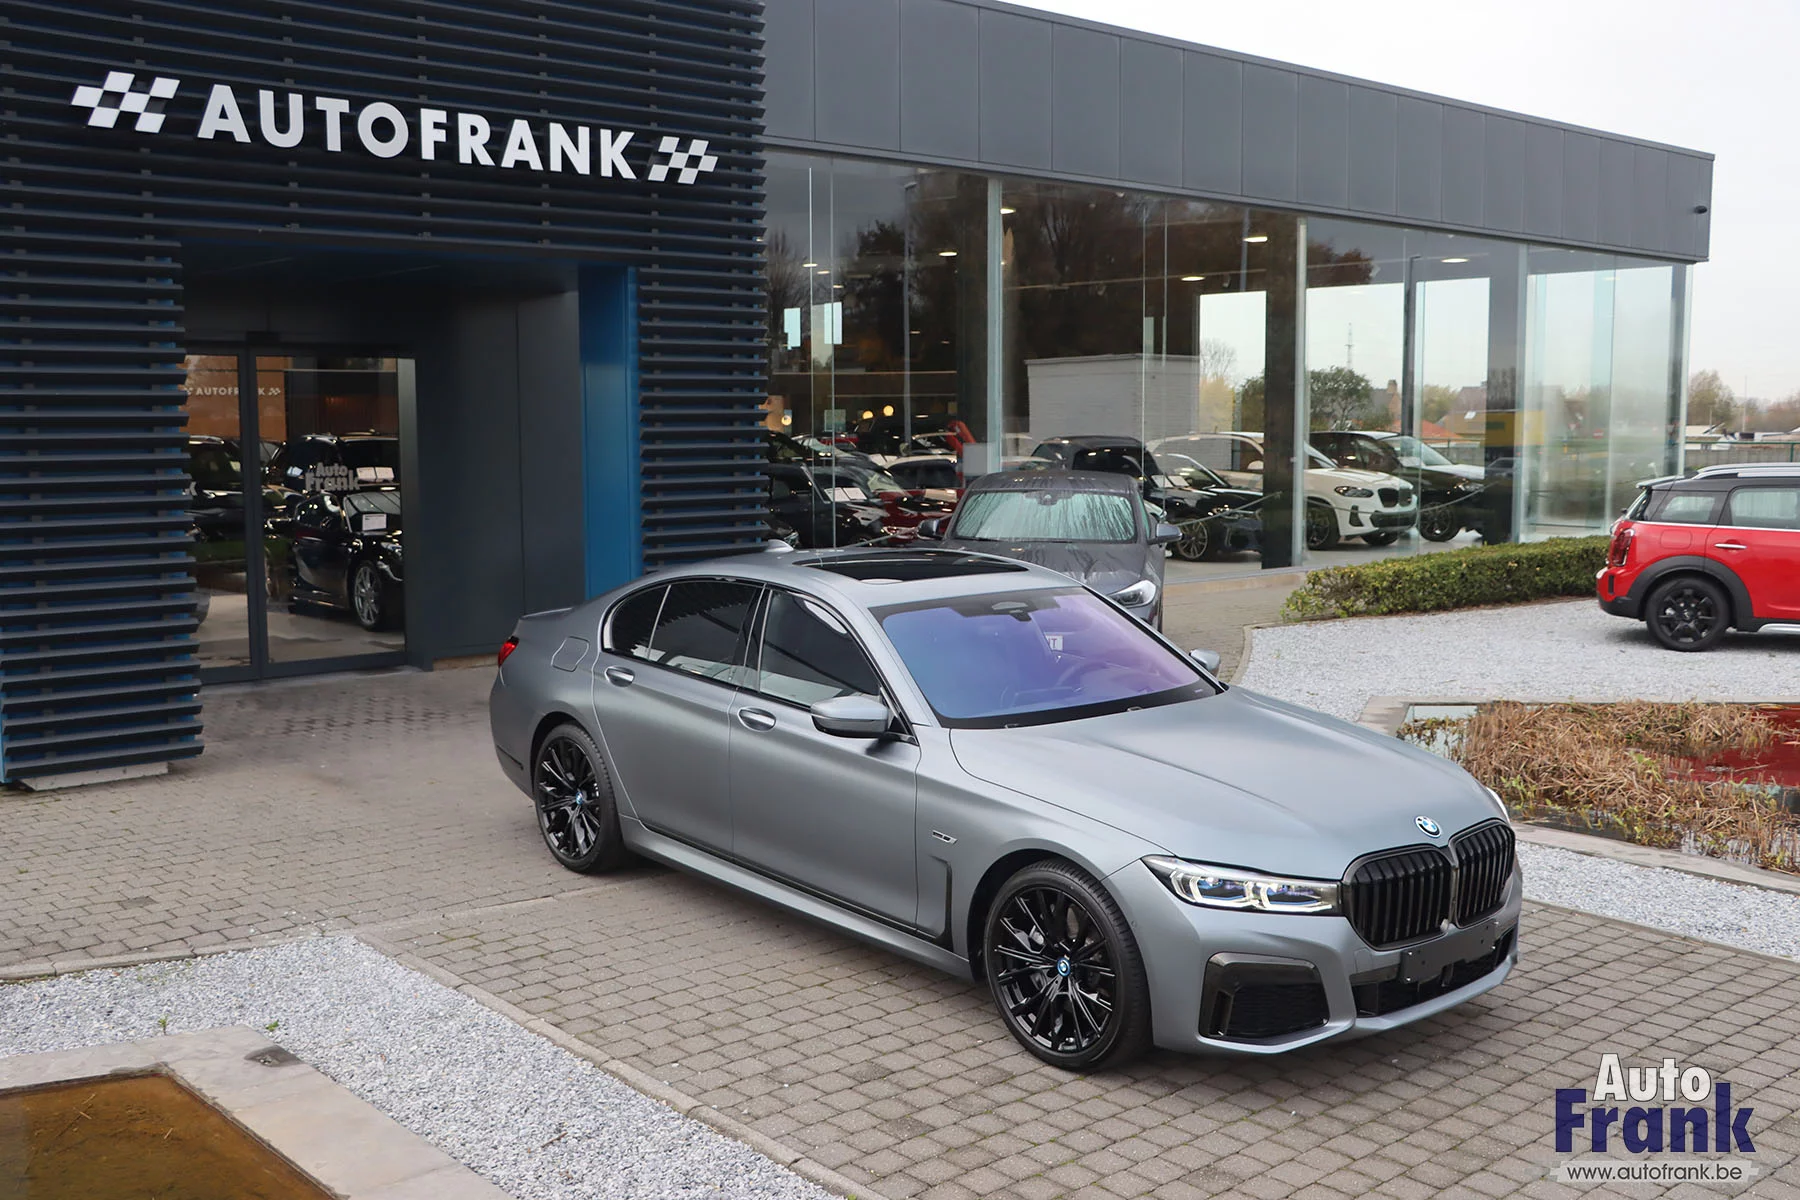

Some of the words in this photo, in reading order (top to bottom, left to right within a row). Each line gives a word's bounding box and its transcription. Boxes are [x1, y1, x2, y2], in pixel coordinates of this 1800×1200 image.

[197, 83, 638, 180] AUTOFRANK
[316, 461, 348, 477] Auto
[305, 470, 360, 491] Frank
